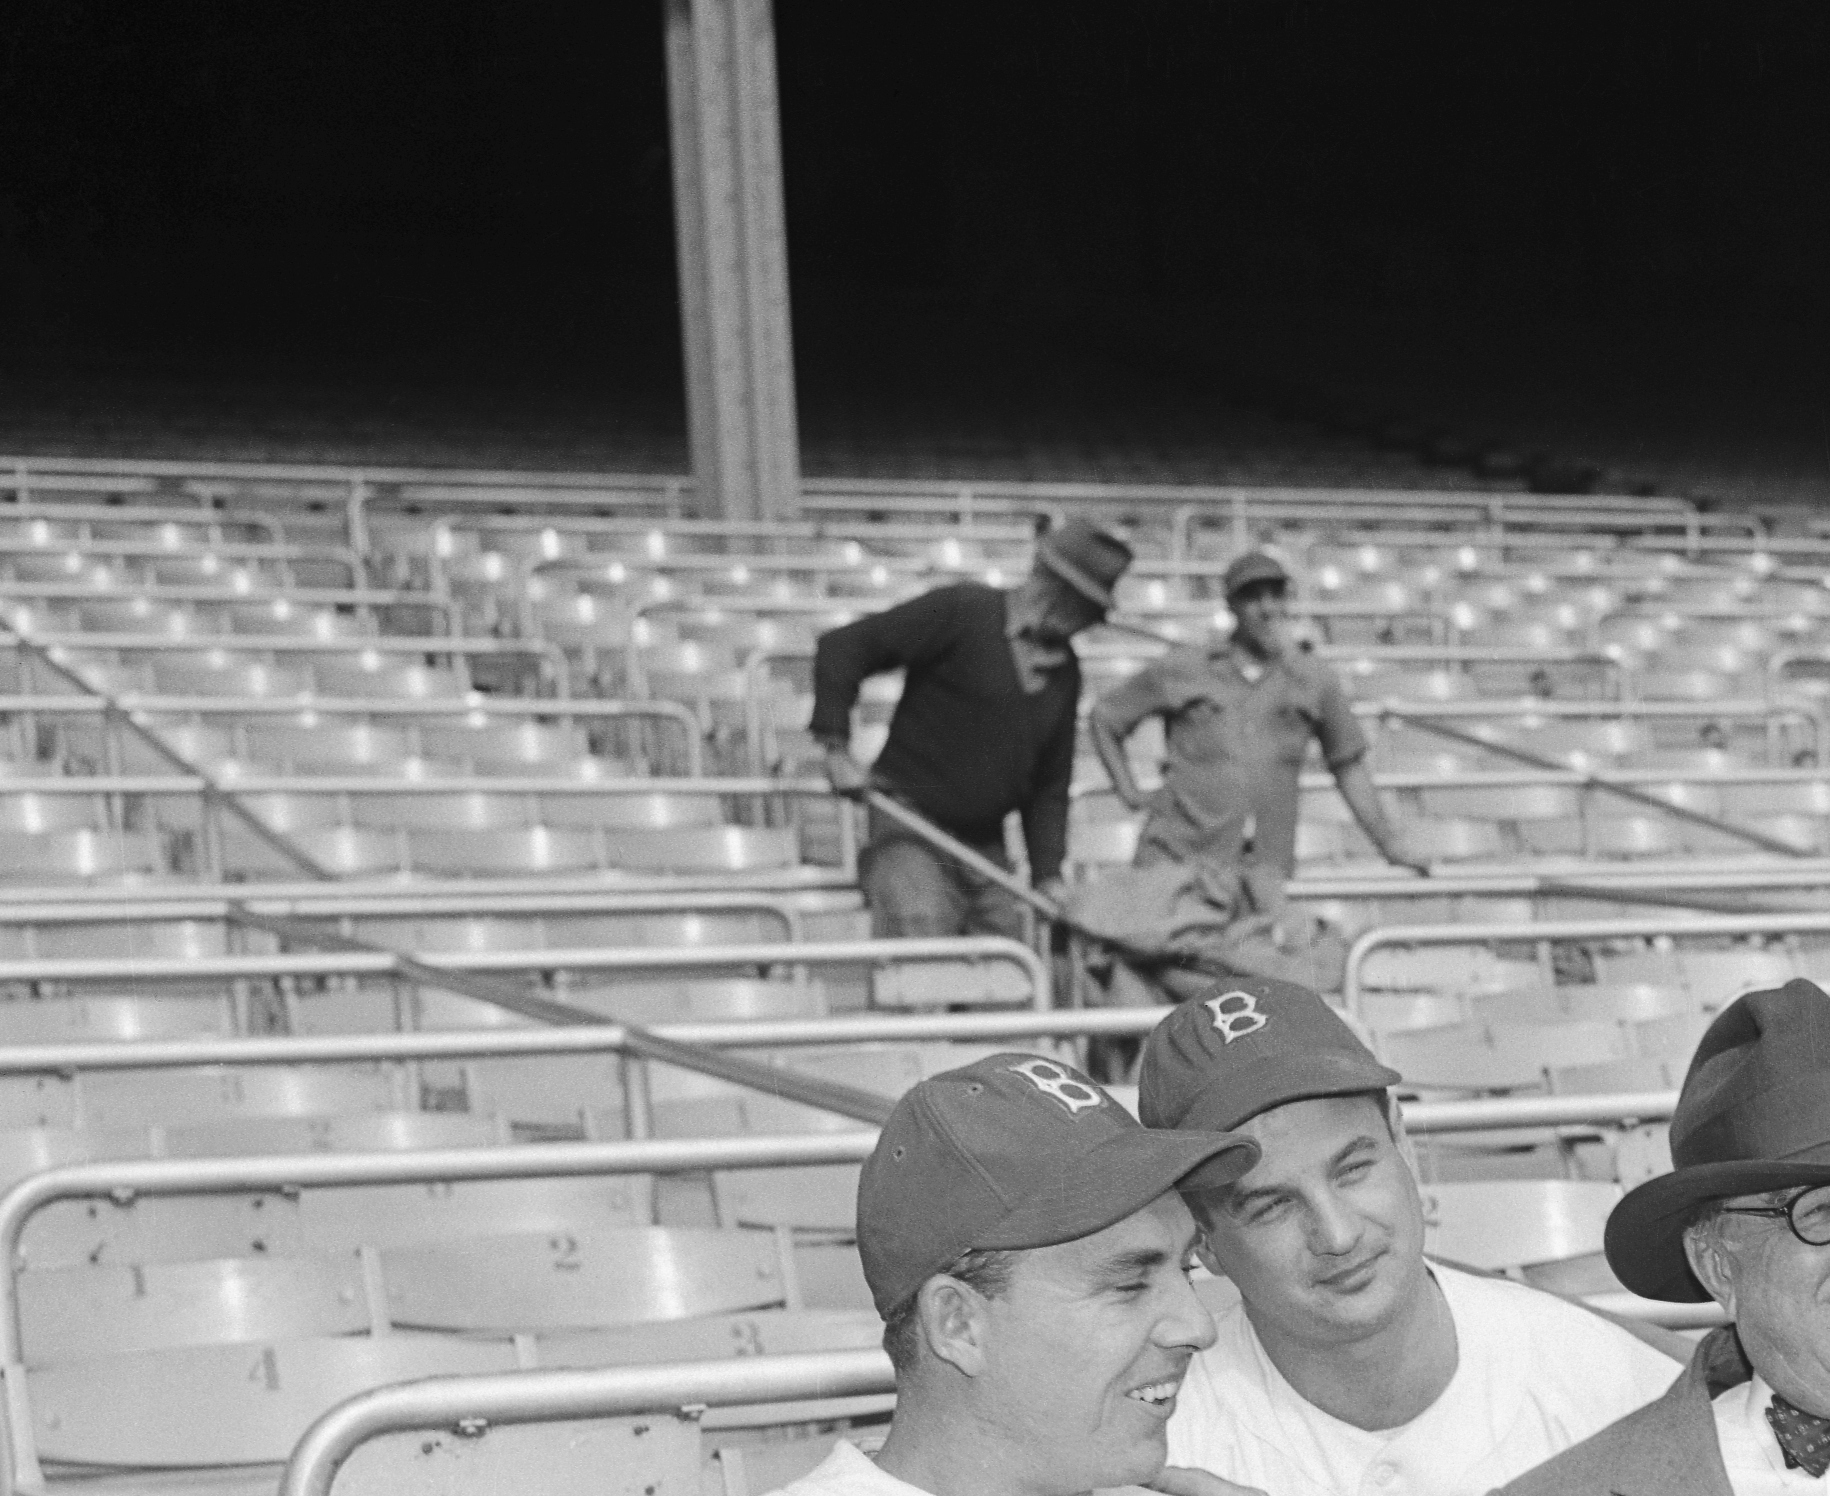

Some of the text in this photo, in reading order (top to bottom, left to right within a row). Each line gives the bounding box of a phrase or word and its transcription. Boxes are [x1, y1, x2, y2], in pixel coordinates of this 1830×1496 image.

[1204, 990, 1268, 1045] B
[1009, 1059, 1103, 1113] B
[548, 1234, 583, 1273] 2
[128, 1261, 148, 1300] 1
[730, 1320, 765, 1356] 3
[247, 1346, 281, 1392] 4
